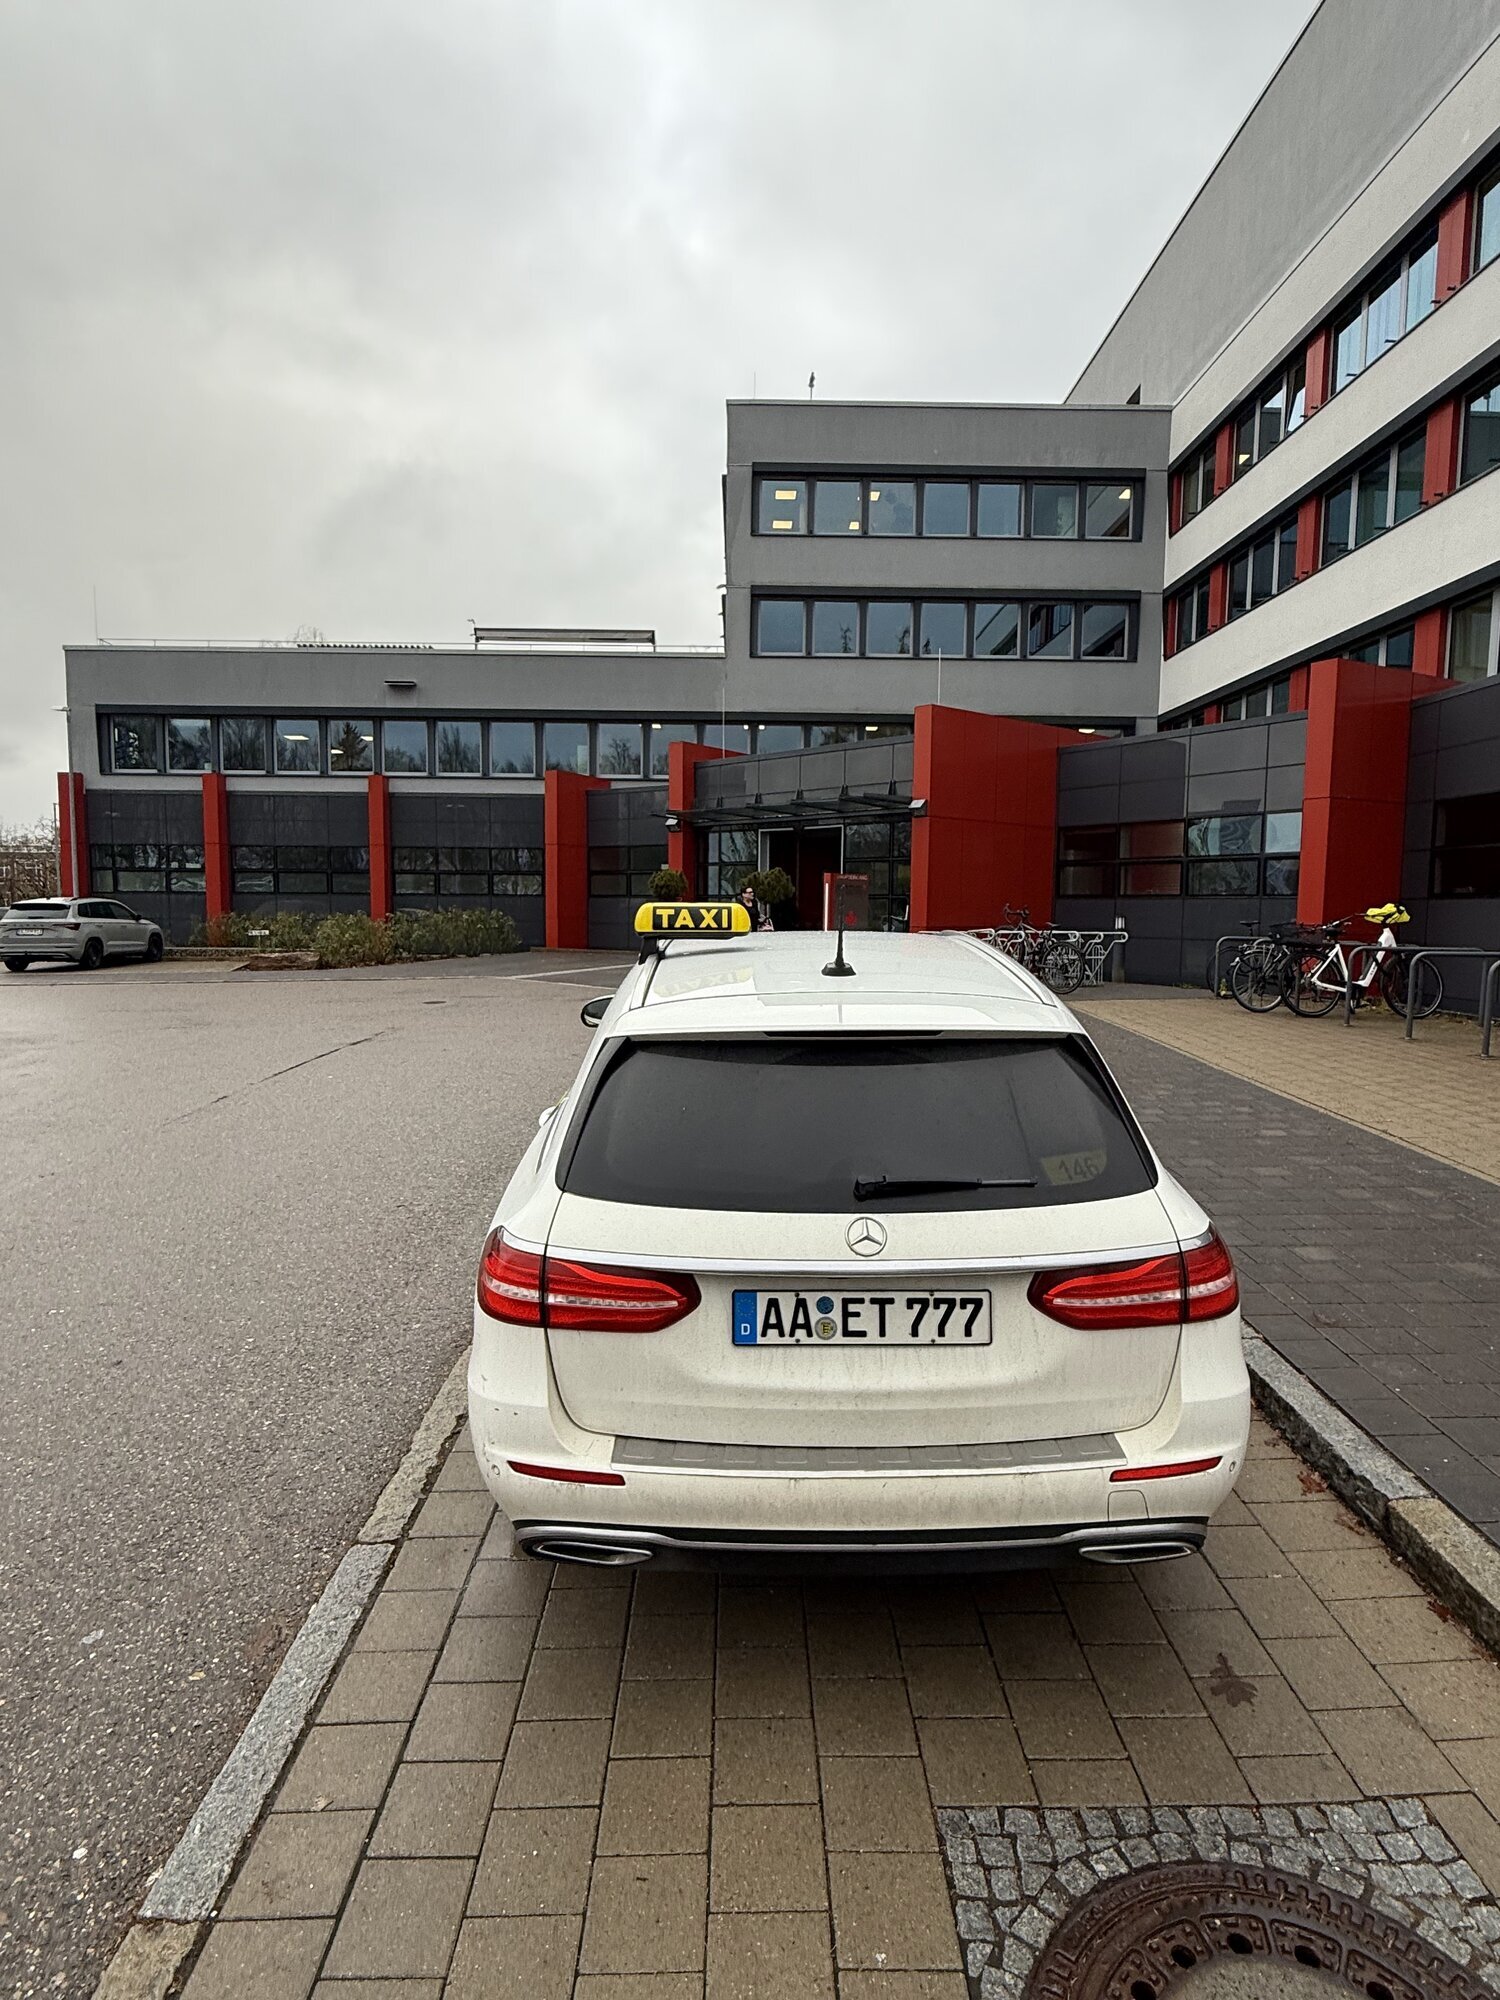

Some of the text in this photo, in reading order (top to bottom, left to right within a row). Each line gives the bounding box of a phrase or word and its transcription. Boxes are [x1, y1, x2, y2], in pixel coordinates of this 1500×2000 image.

[655, 908, 729, 928] TAXI
[760, 1297, 984, 1338] AA ET 777
[740, 1323, 751, 1335] D
